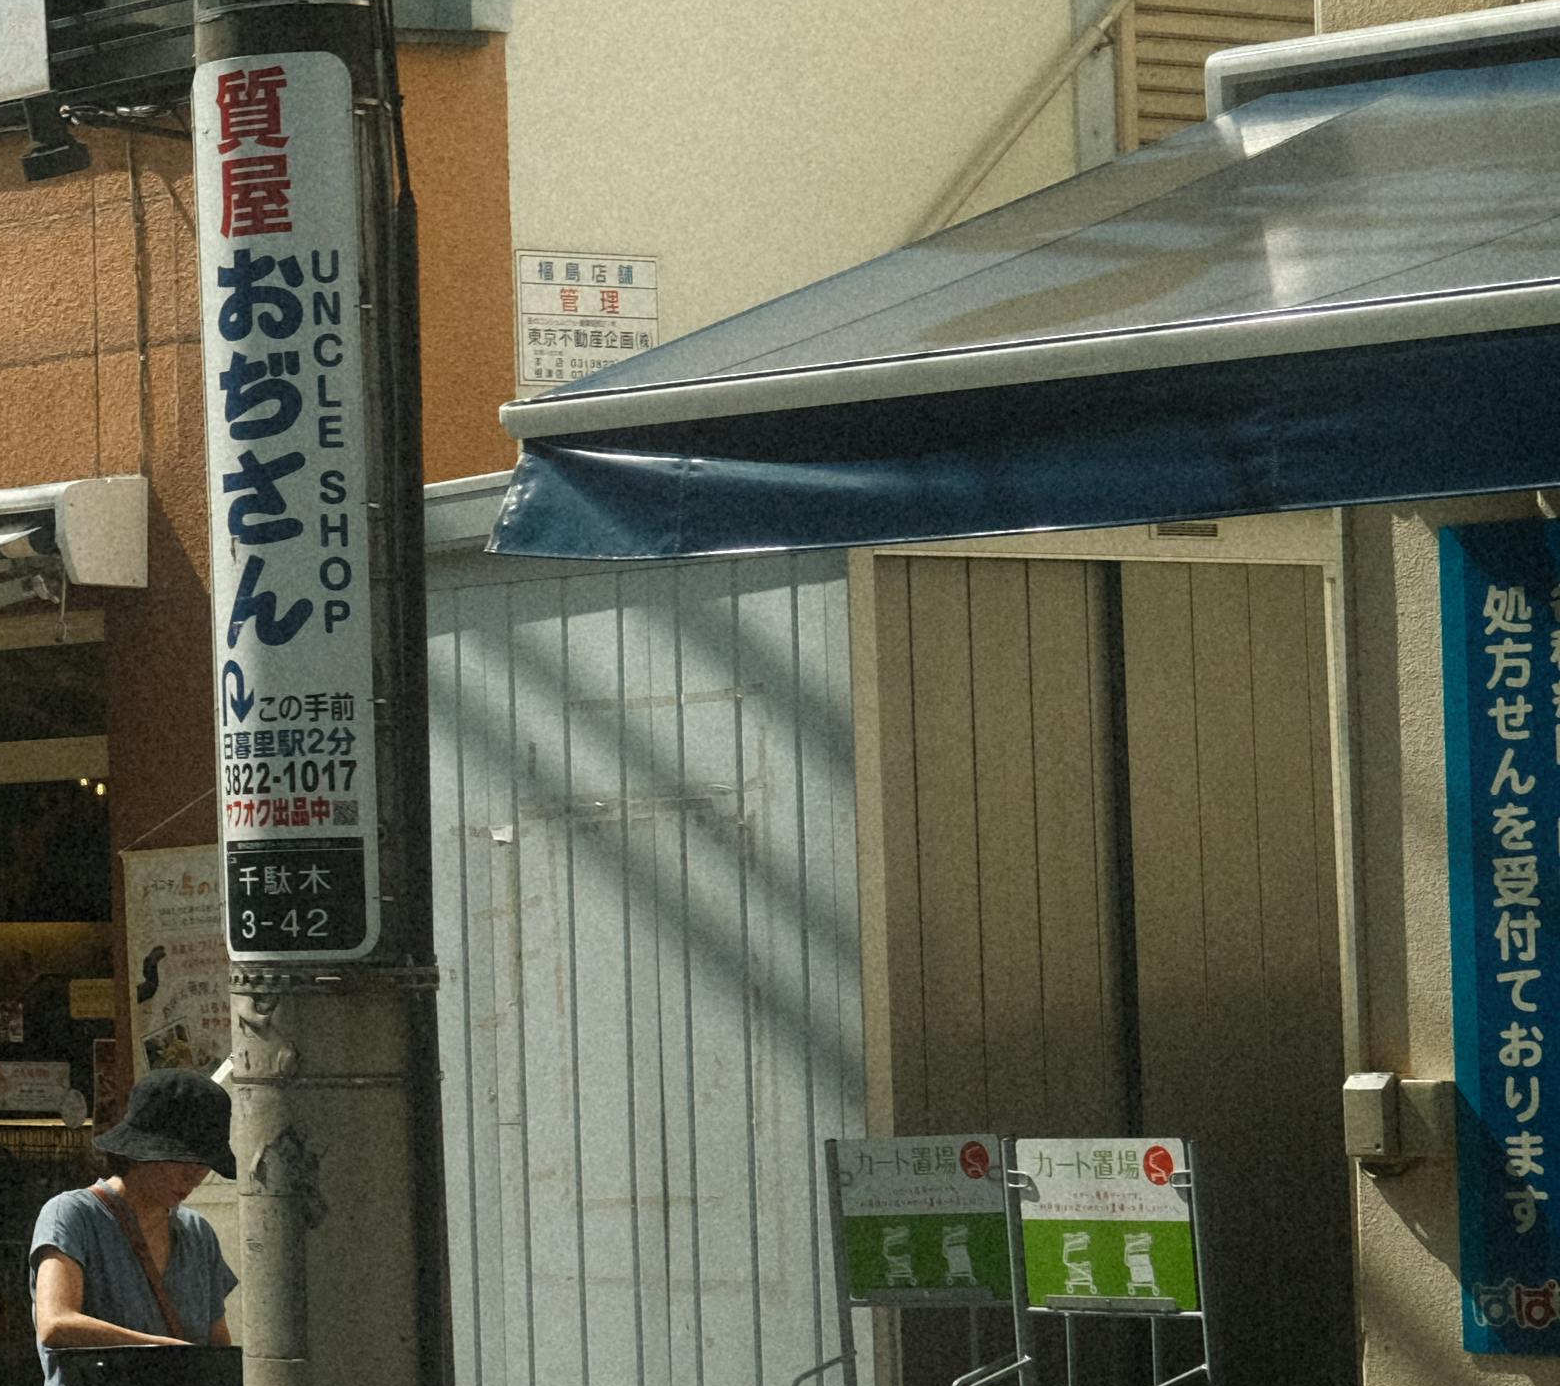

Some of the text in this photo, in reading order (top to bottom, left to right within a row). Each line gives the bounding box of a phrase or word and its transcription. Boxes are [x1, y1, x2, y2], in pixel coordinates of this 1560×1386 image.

[214, 66, 292, 239] 質屋
[538, 261, 634, 285] 福島店舗
[560, 287, 621, 315] 管理
[527, 327, 654, 351] 東京不動産企画(株)
[217, 246, 314, 651] おぢさん
[311, 250, 353, 634] UNCLE SHOP
[258, 692, 355, 723] この手前
[223, 727, 356, 761] 日暮里駅2分
[225, 759, 358, 796] 3822-1017
[238, 863, 332, 897] 千駄木
[241, 908, 330, 940] 3-42
[1483, 584, 1549, 1234] 処方せんを受付ております
[856, 1146, 957, 1178] カート置場
[1034, 1148, 1141, 1183] カート置場
